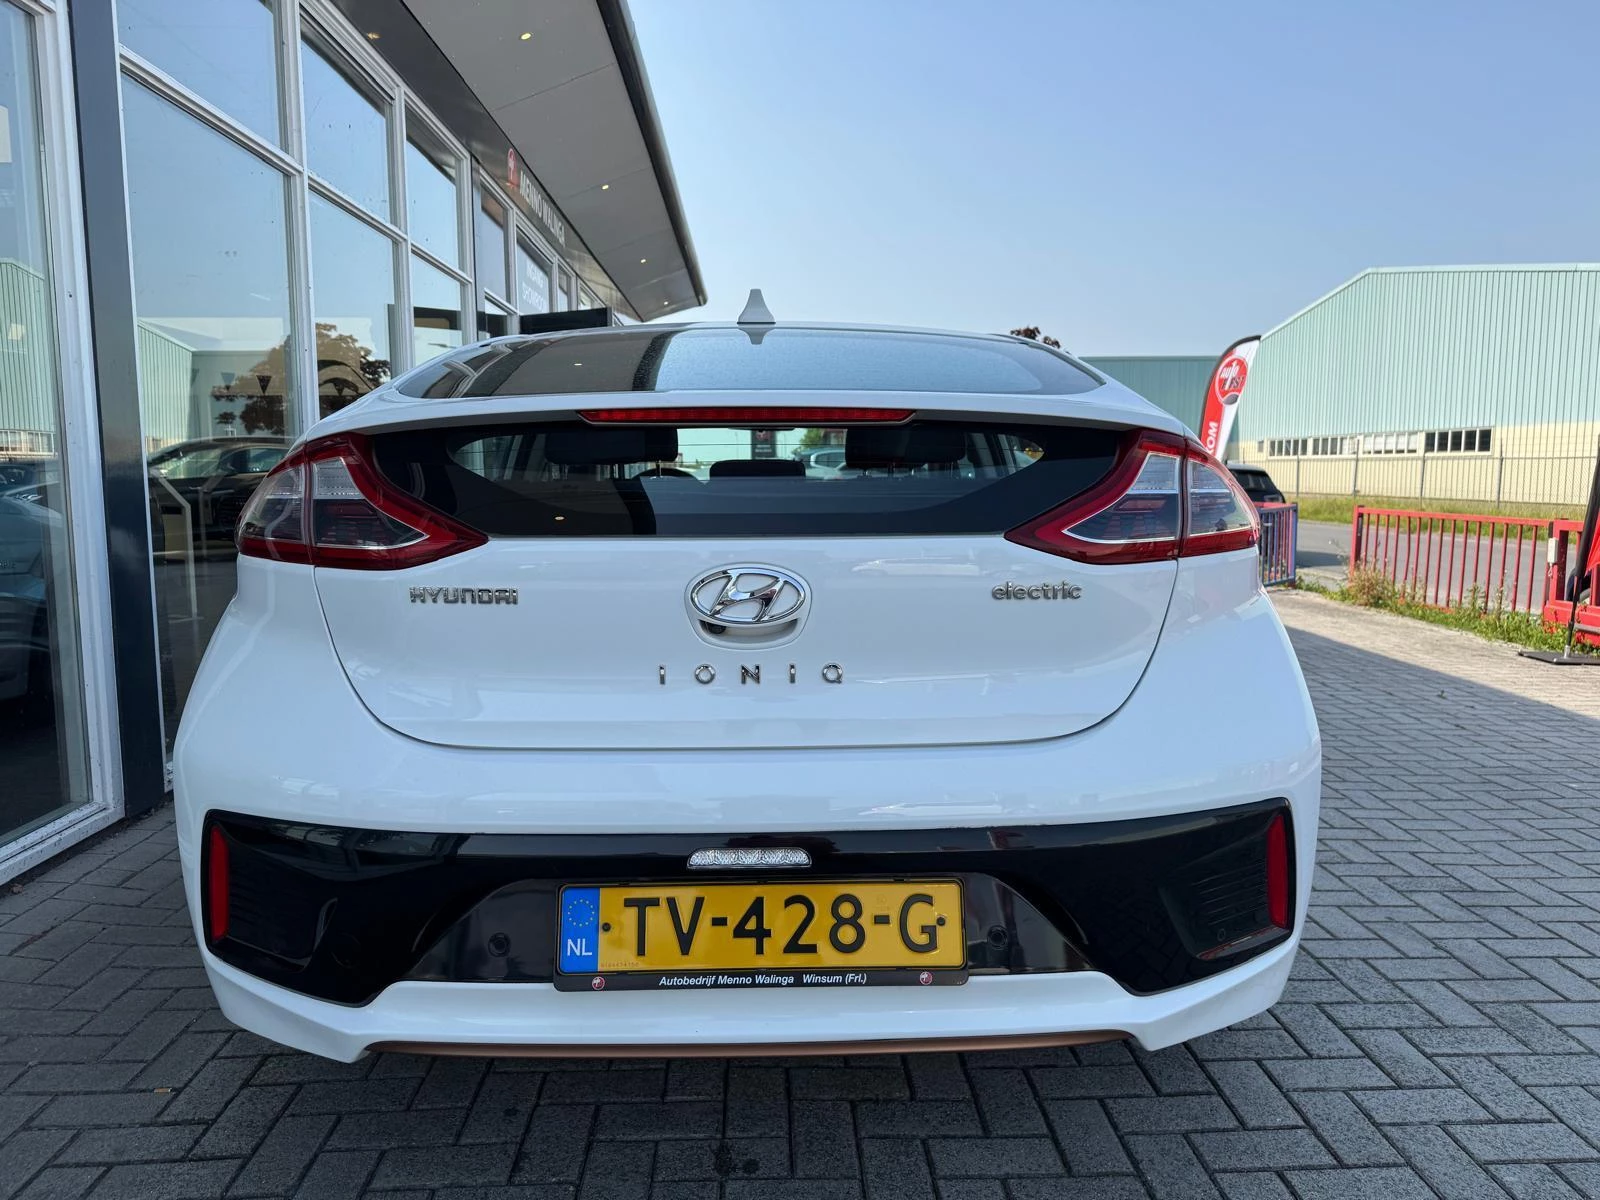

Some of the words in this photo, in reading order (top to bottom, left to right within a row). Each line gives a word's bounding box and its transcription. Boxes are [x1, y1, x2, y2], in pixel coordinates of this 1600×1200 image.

[520, 170, 542, 218] MENNO
[542, 199, 565, 248] WALINGA
[410, 587, 519, 604] HYUNDAI
[992, 580, 1081, 600] electric
[658, 664, 844, 686] IONIQ
[623, 894, 939, 957] TV-428-G
[566, 938, 592, 957] NL
[659, 975, 716, 986] Autobedrijf
[717, 975, 752, 985] Menno
[754, 974, 794, 986] Walinga
[802, 973, 843, 984] Winsum
[845, 972, 867, 984] (Frl.)
